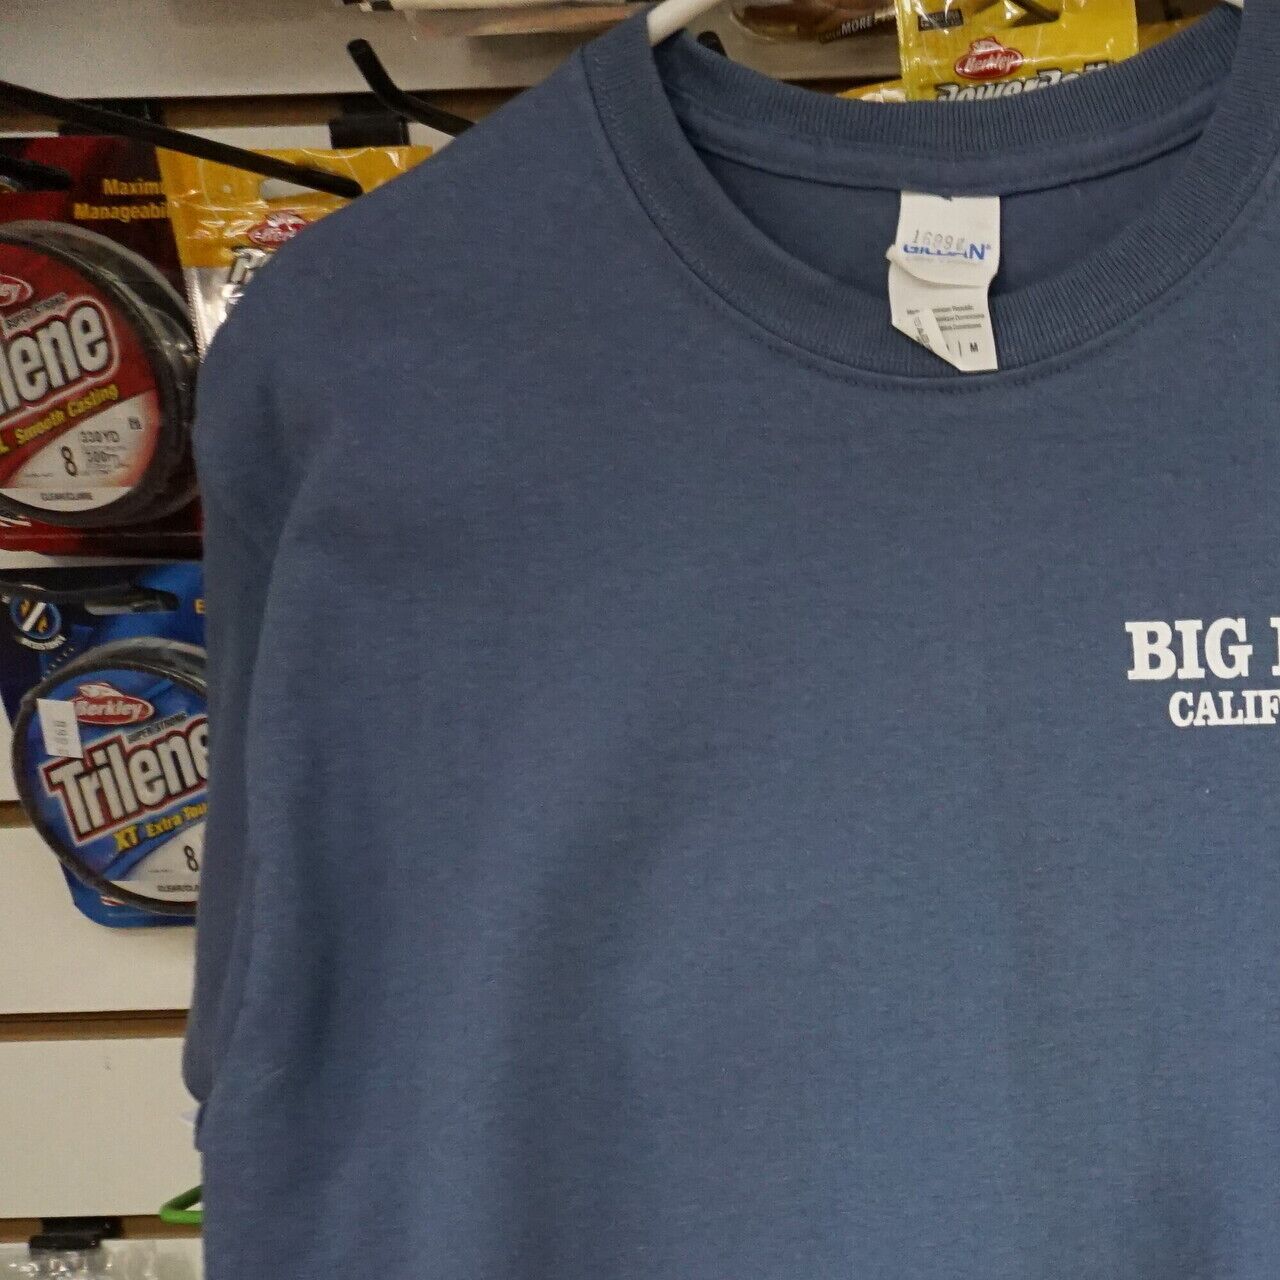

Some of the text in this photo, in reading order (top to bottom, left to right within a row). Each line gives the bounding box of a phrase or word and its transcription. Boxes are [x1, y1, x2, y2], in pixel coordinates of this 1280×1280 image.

[15, 406, 65, 445] Smooth
[67, 384, 119, 418] Casting
[61, 445, 77, 477] 8
[1125, 617, 1253, 681] BIG
[113, 825, 140, 851] XT
[147, 812, 184, 835] Extra
[184, 845, 199, 874] 8
